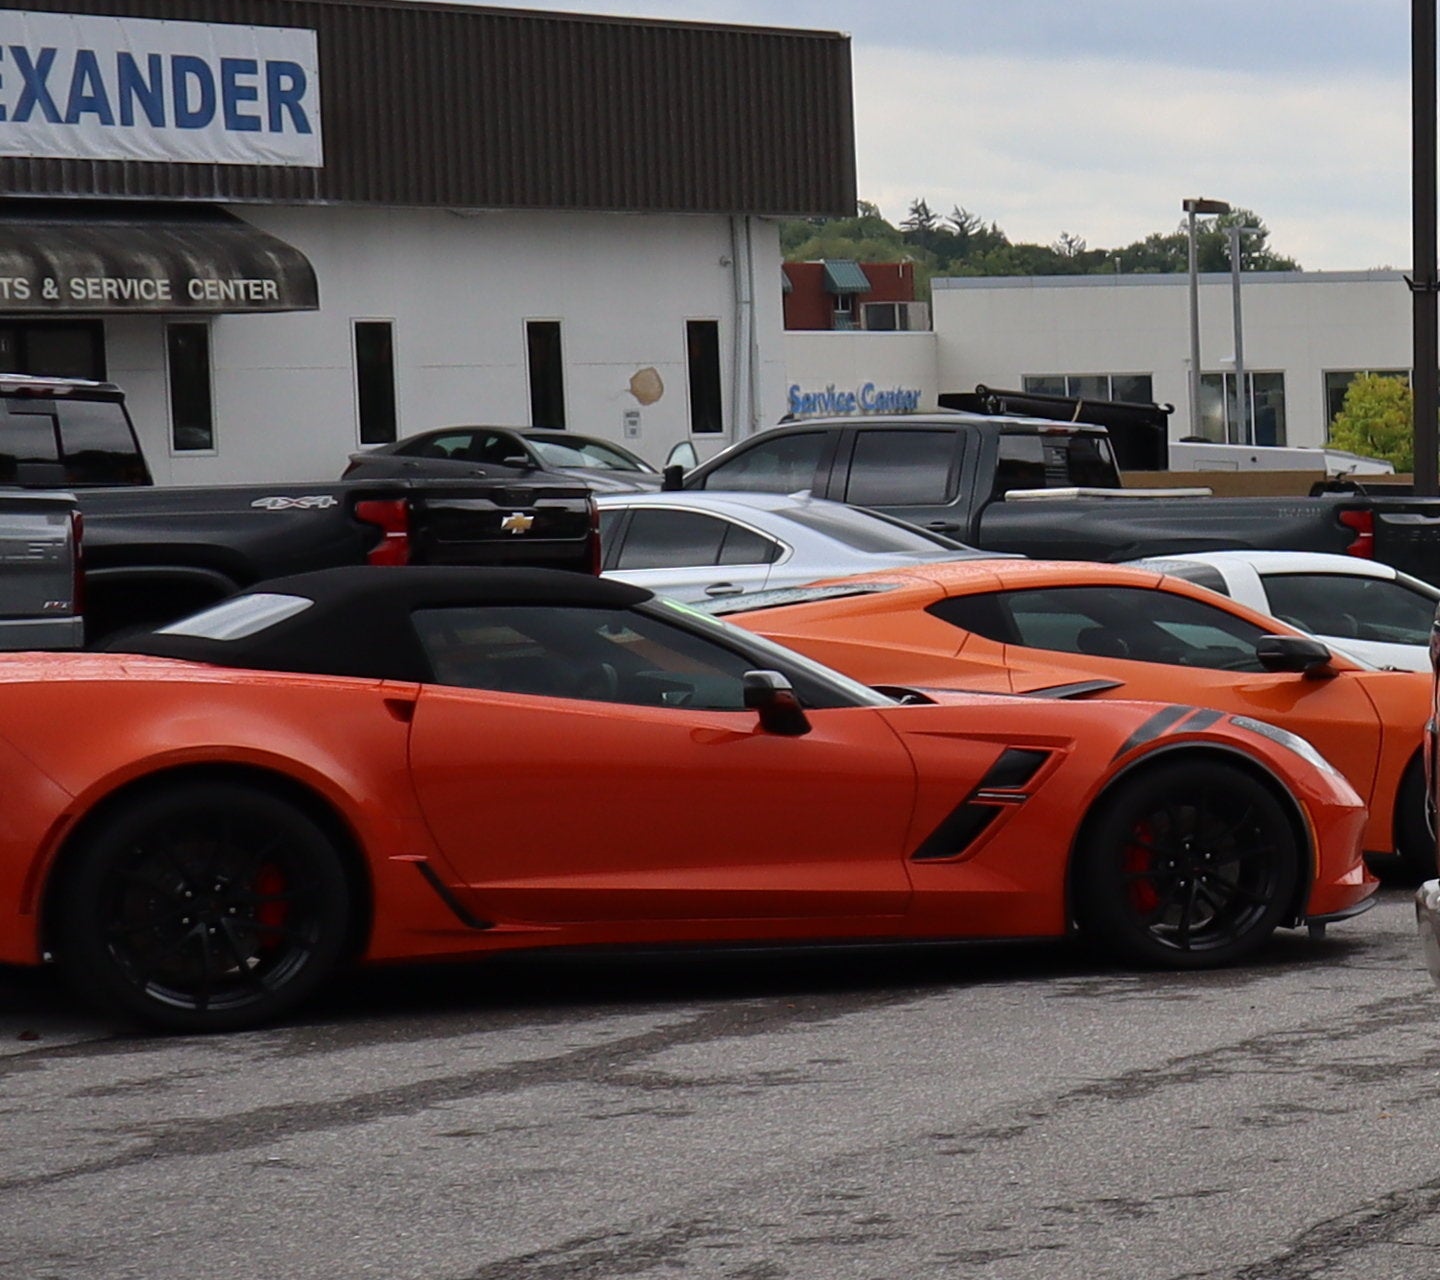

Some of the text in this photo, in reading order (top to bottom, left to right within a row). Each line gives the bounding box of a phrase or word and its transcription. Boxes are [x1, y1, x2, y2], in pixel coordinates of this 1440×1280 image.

[0, 45, 312, 134] XANDER
[42, 277, 59, 300] &
[70, 278, 172, 300] SERVICE
[188, 279, 279, 300] CENTER
[789, 382, 922, 415] Service Center
